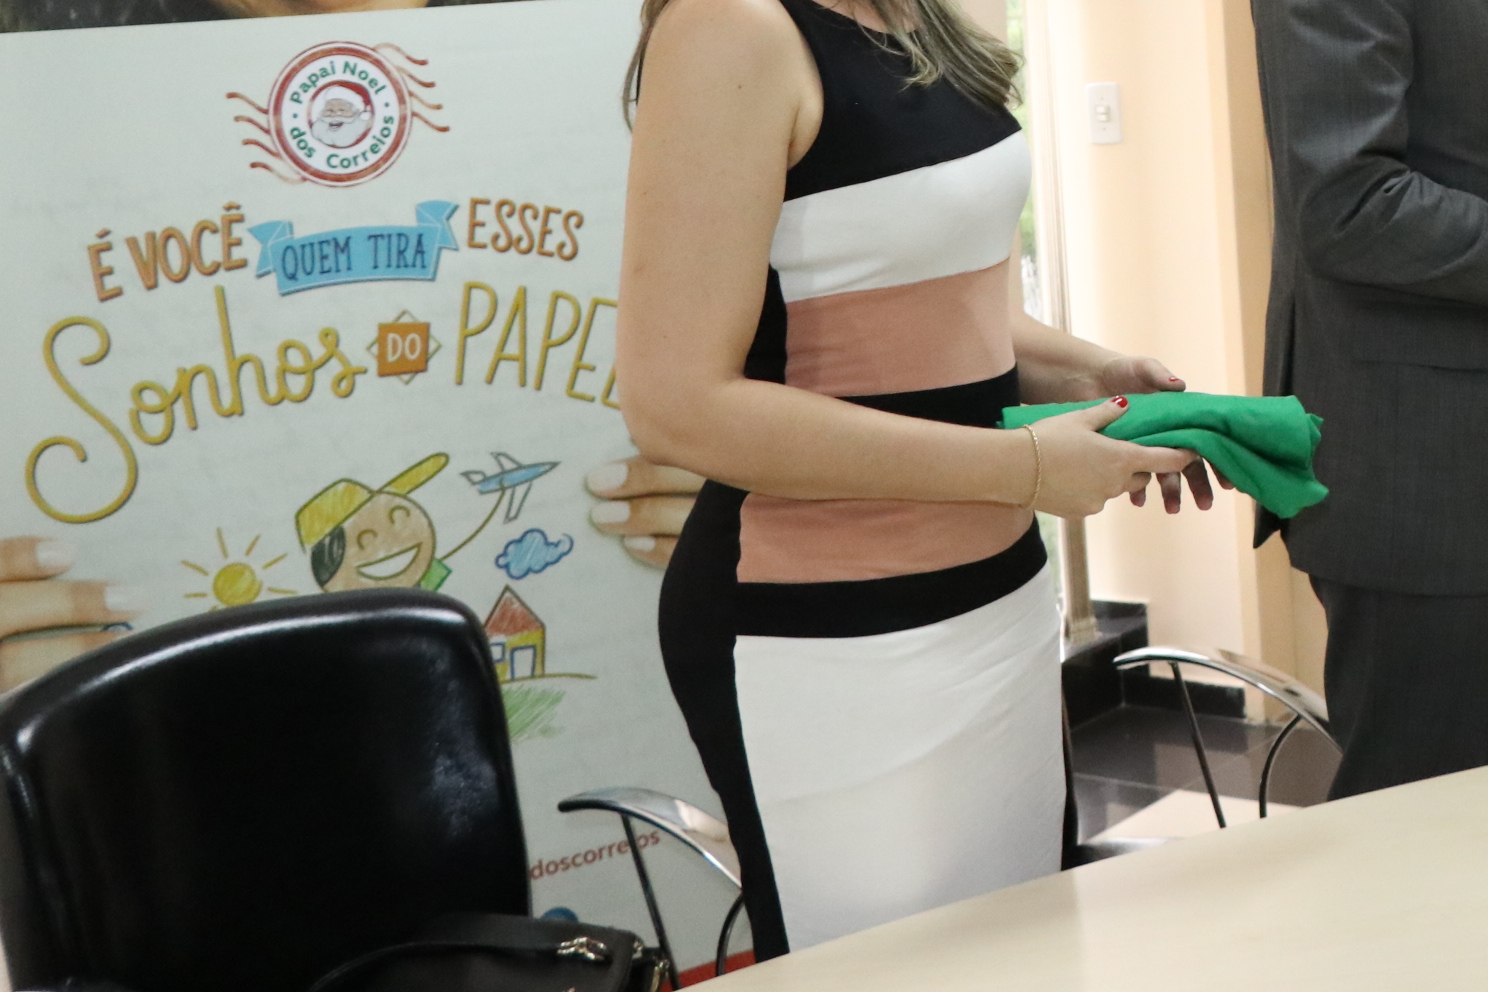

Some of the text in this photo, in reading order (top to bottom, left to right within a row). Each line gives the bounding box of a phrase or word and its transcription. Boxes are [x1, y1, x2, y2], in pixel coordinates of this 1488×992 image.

[289, 60, 387, 105] Papai Noel
[289, 114, 395, 169] dos Correios
[87, 197, 584, 303] É VOCÊ QUEM TIRA ESSES
[24, 284, 369, 525] Sonhos
[386, 332, 422, 363] DO
[529, 830, 661, 881] doscorreos
